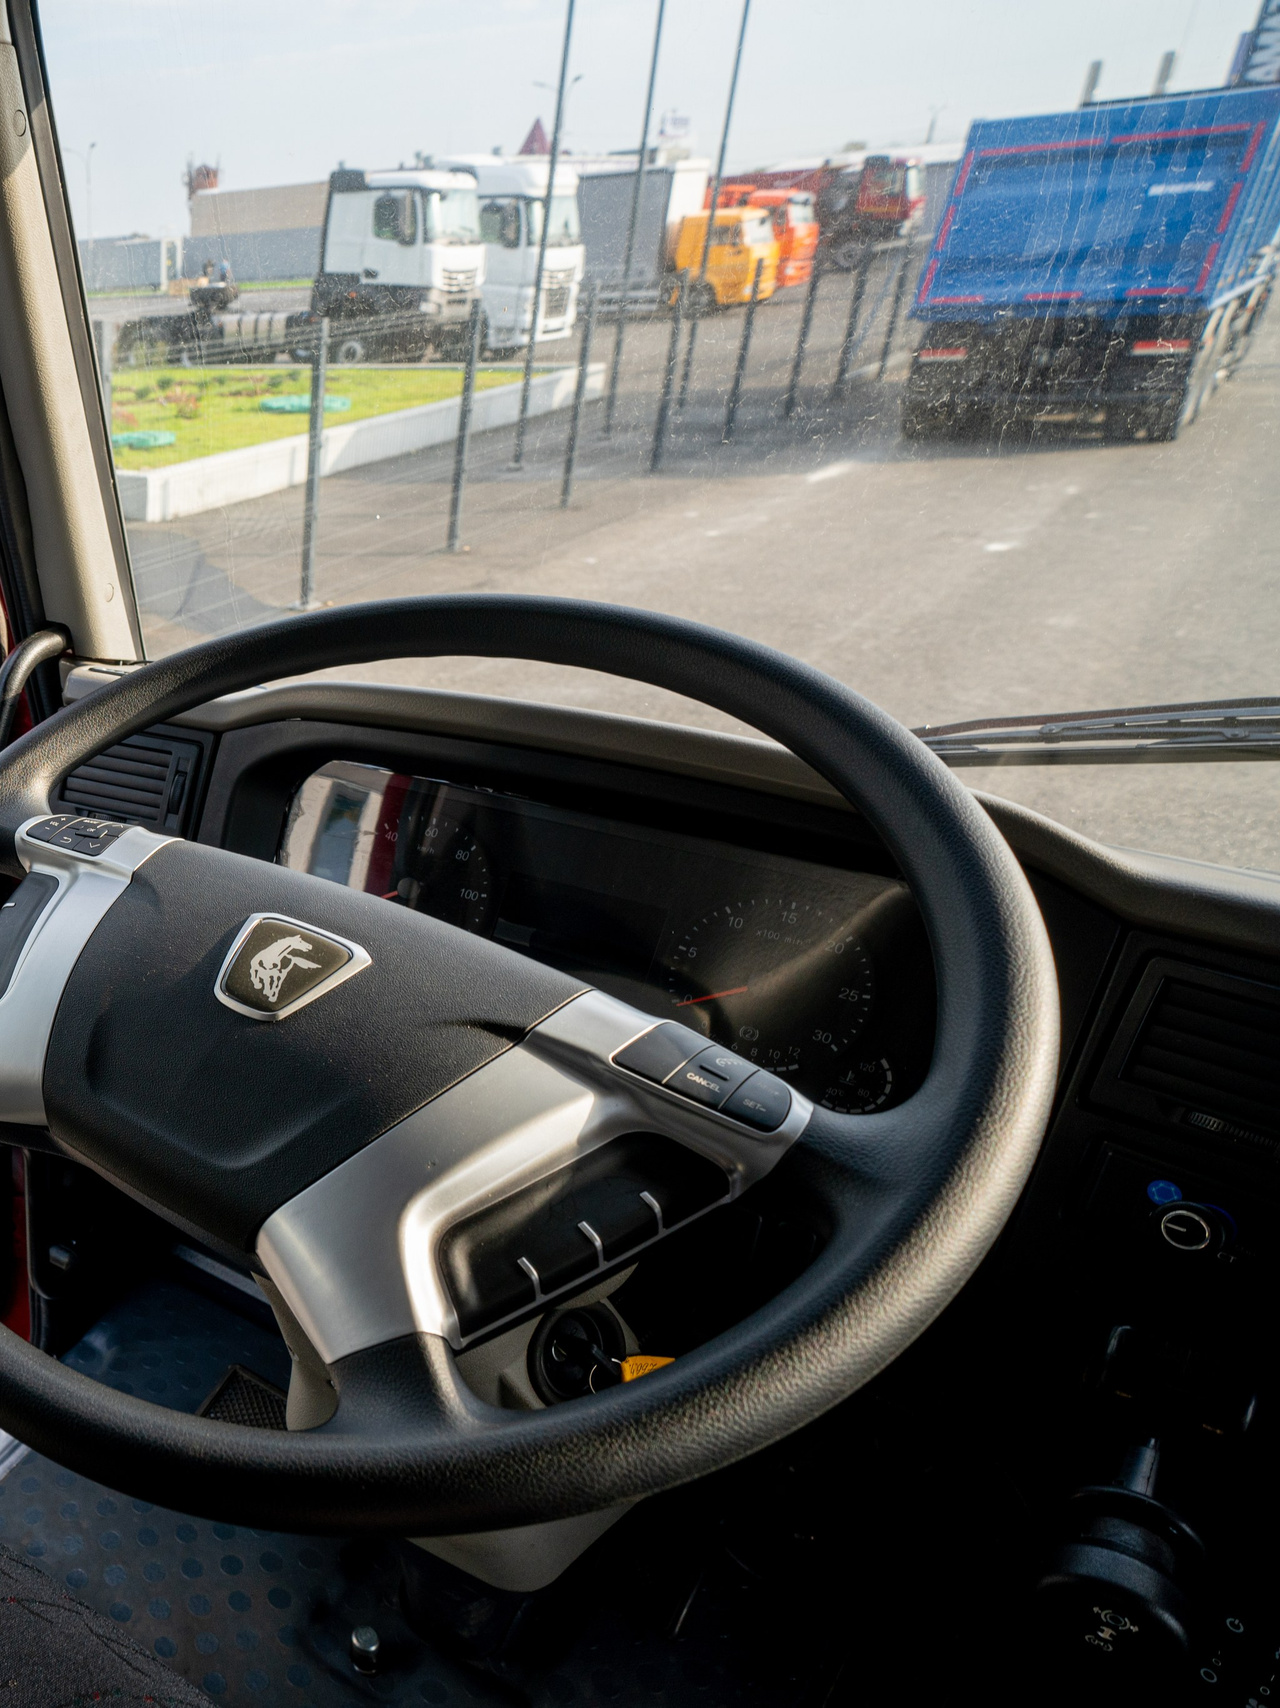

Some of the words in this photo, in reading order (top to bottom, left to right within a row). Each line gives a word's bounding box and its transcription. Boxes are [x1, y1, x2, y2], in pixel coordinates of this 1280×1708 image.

[384, 830, 399, 842] 40
[424, 827, 439, 839] 60
[454, 849, 471, 862] 80
[459, 887, 480, 902] 100
[727, 916, 744, 929] 10
[780, 911, 798, 925] 15
[687, 946, 698, 959] 5
[824, 940, 845, 955] 20
[837, 987, 860, 1002] 25
[811, 1029, 833, 1045] 30
[730, 1042, 738, 1051] 6
[750, 1047, 760, 1057] 8
[787, 1046, 802, 1057] 12
[768, 1048, 781, 1060] 10
[685, 1072, 721, 1093] CANCEL
[857, 1087, 871, 1098] 80
